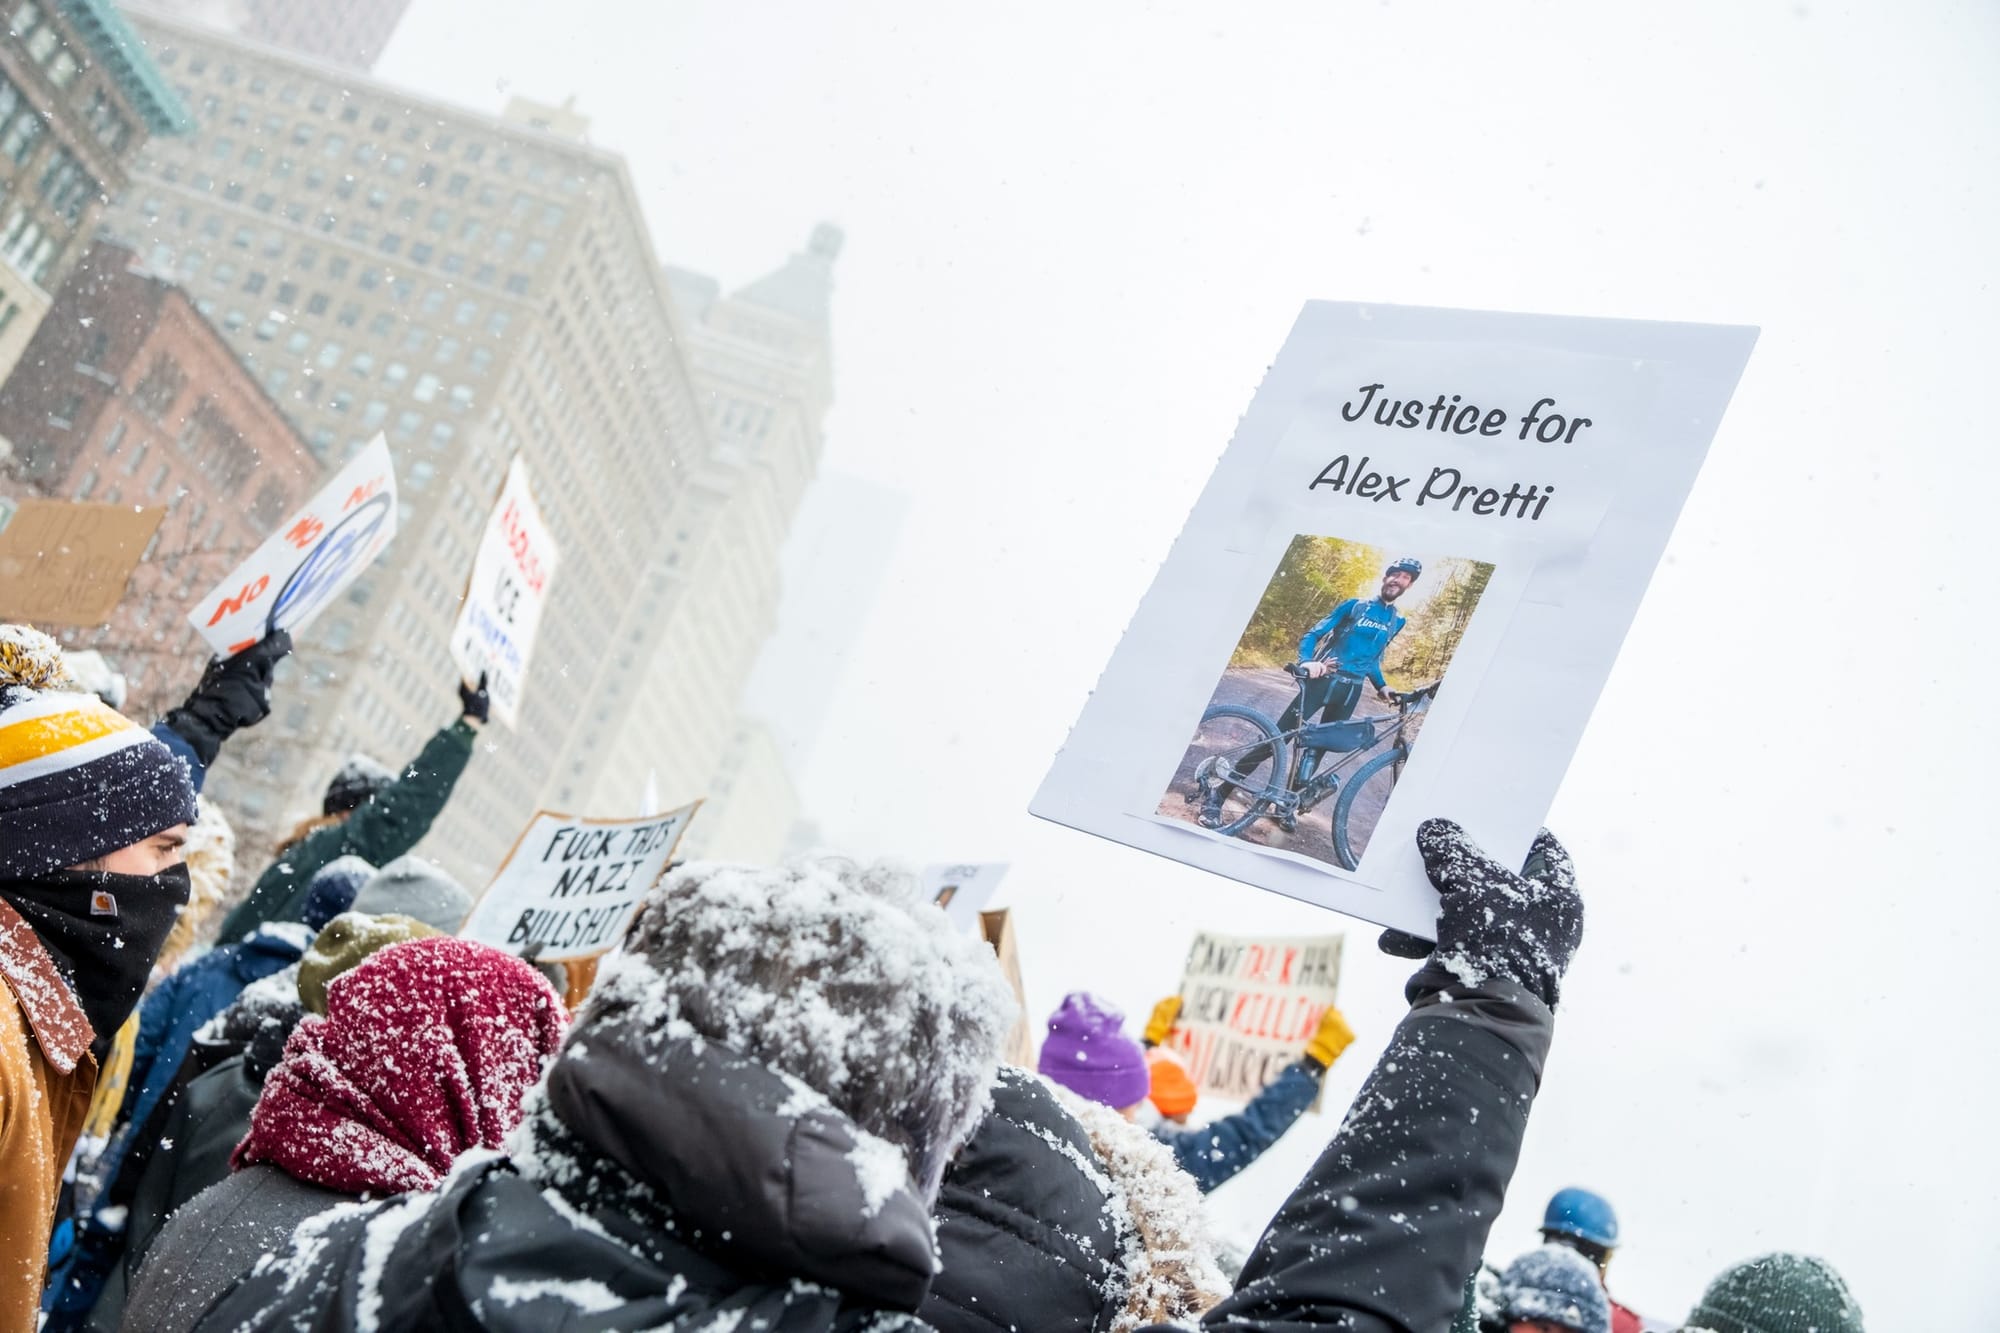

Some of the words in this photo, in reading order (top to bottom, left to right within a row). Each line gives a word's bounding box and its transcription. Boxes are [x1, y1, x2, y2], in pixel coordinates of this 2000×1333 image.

[1341, 383, 1507, 436] Justice
[1518, 398, 1593, 444] for
[1308, 454, 1411, 502] Alex
[1416, 466, 1556, 521] Pretti
[207, 574, 270, 627] NO
[544, 827, 622, 862] FUCK
[622, 818, 676, 855] THIS
[550, 859, 643, 898] NAZI
[507, 902, 632, 947] BULLSHIT
